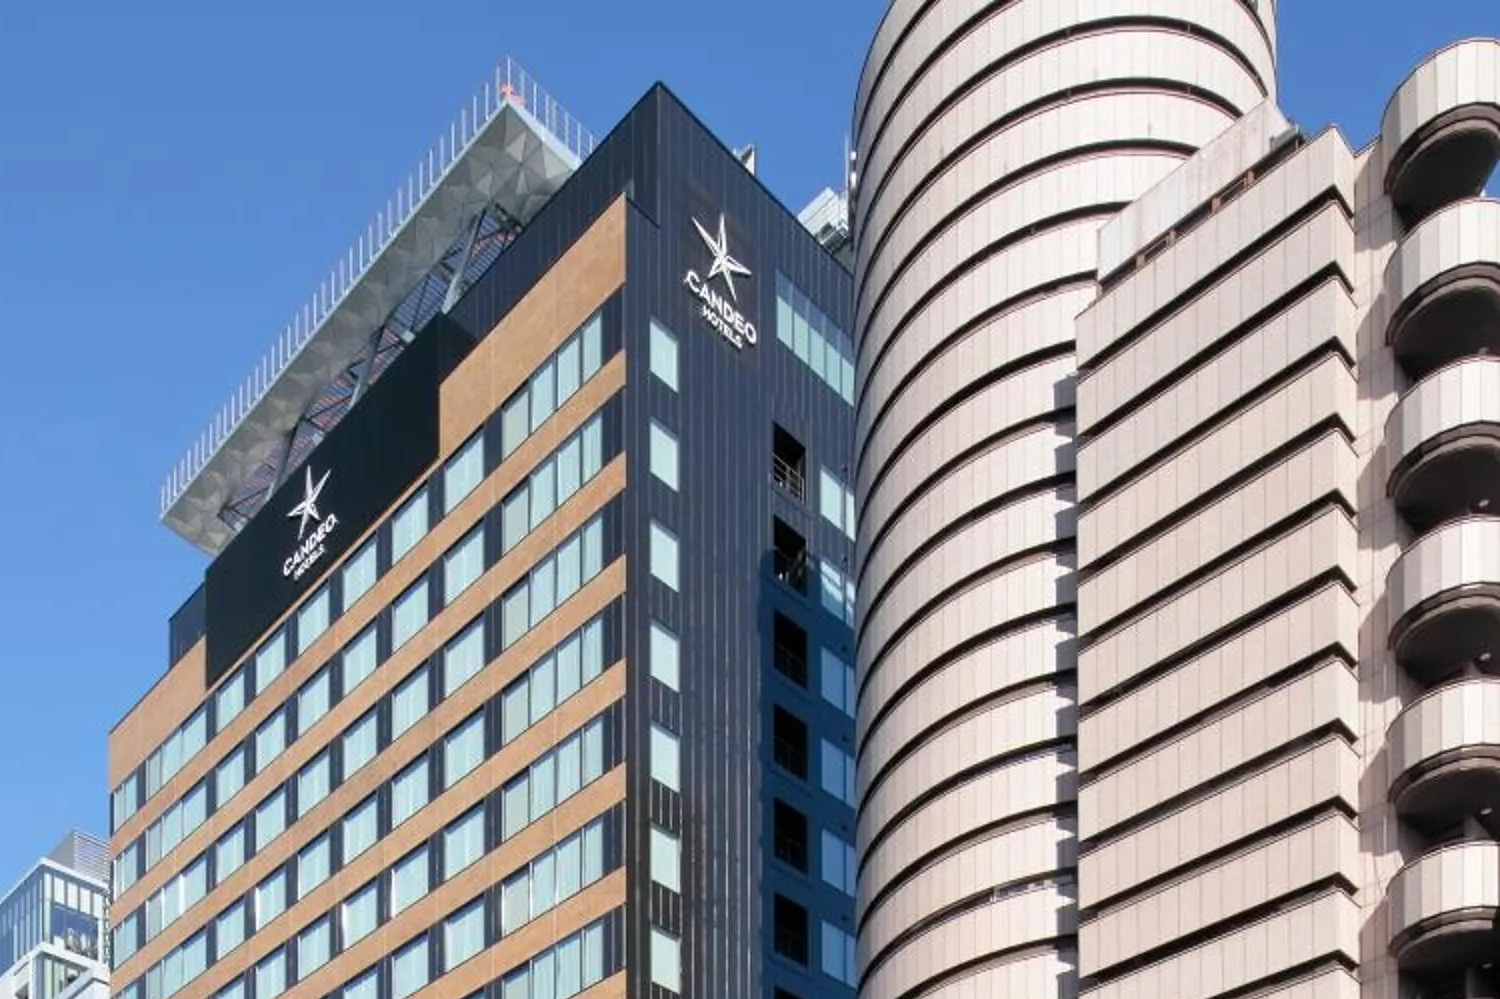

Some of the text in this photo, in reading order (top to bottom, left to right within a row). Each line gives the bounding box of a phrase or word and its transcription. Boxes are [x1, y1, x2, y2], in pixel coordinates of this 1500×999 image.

[684, 269, 757, 345] CANDEO
[702, 306, 743, 350] HOTELS
[283, 513, 338, 577] CANDEO
